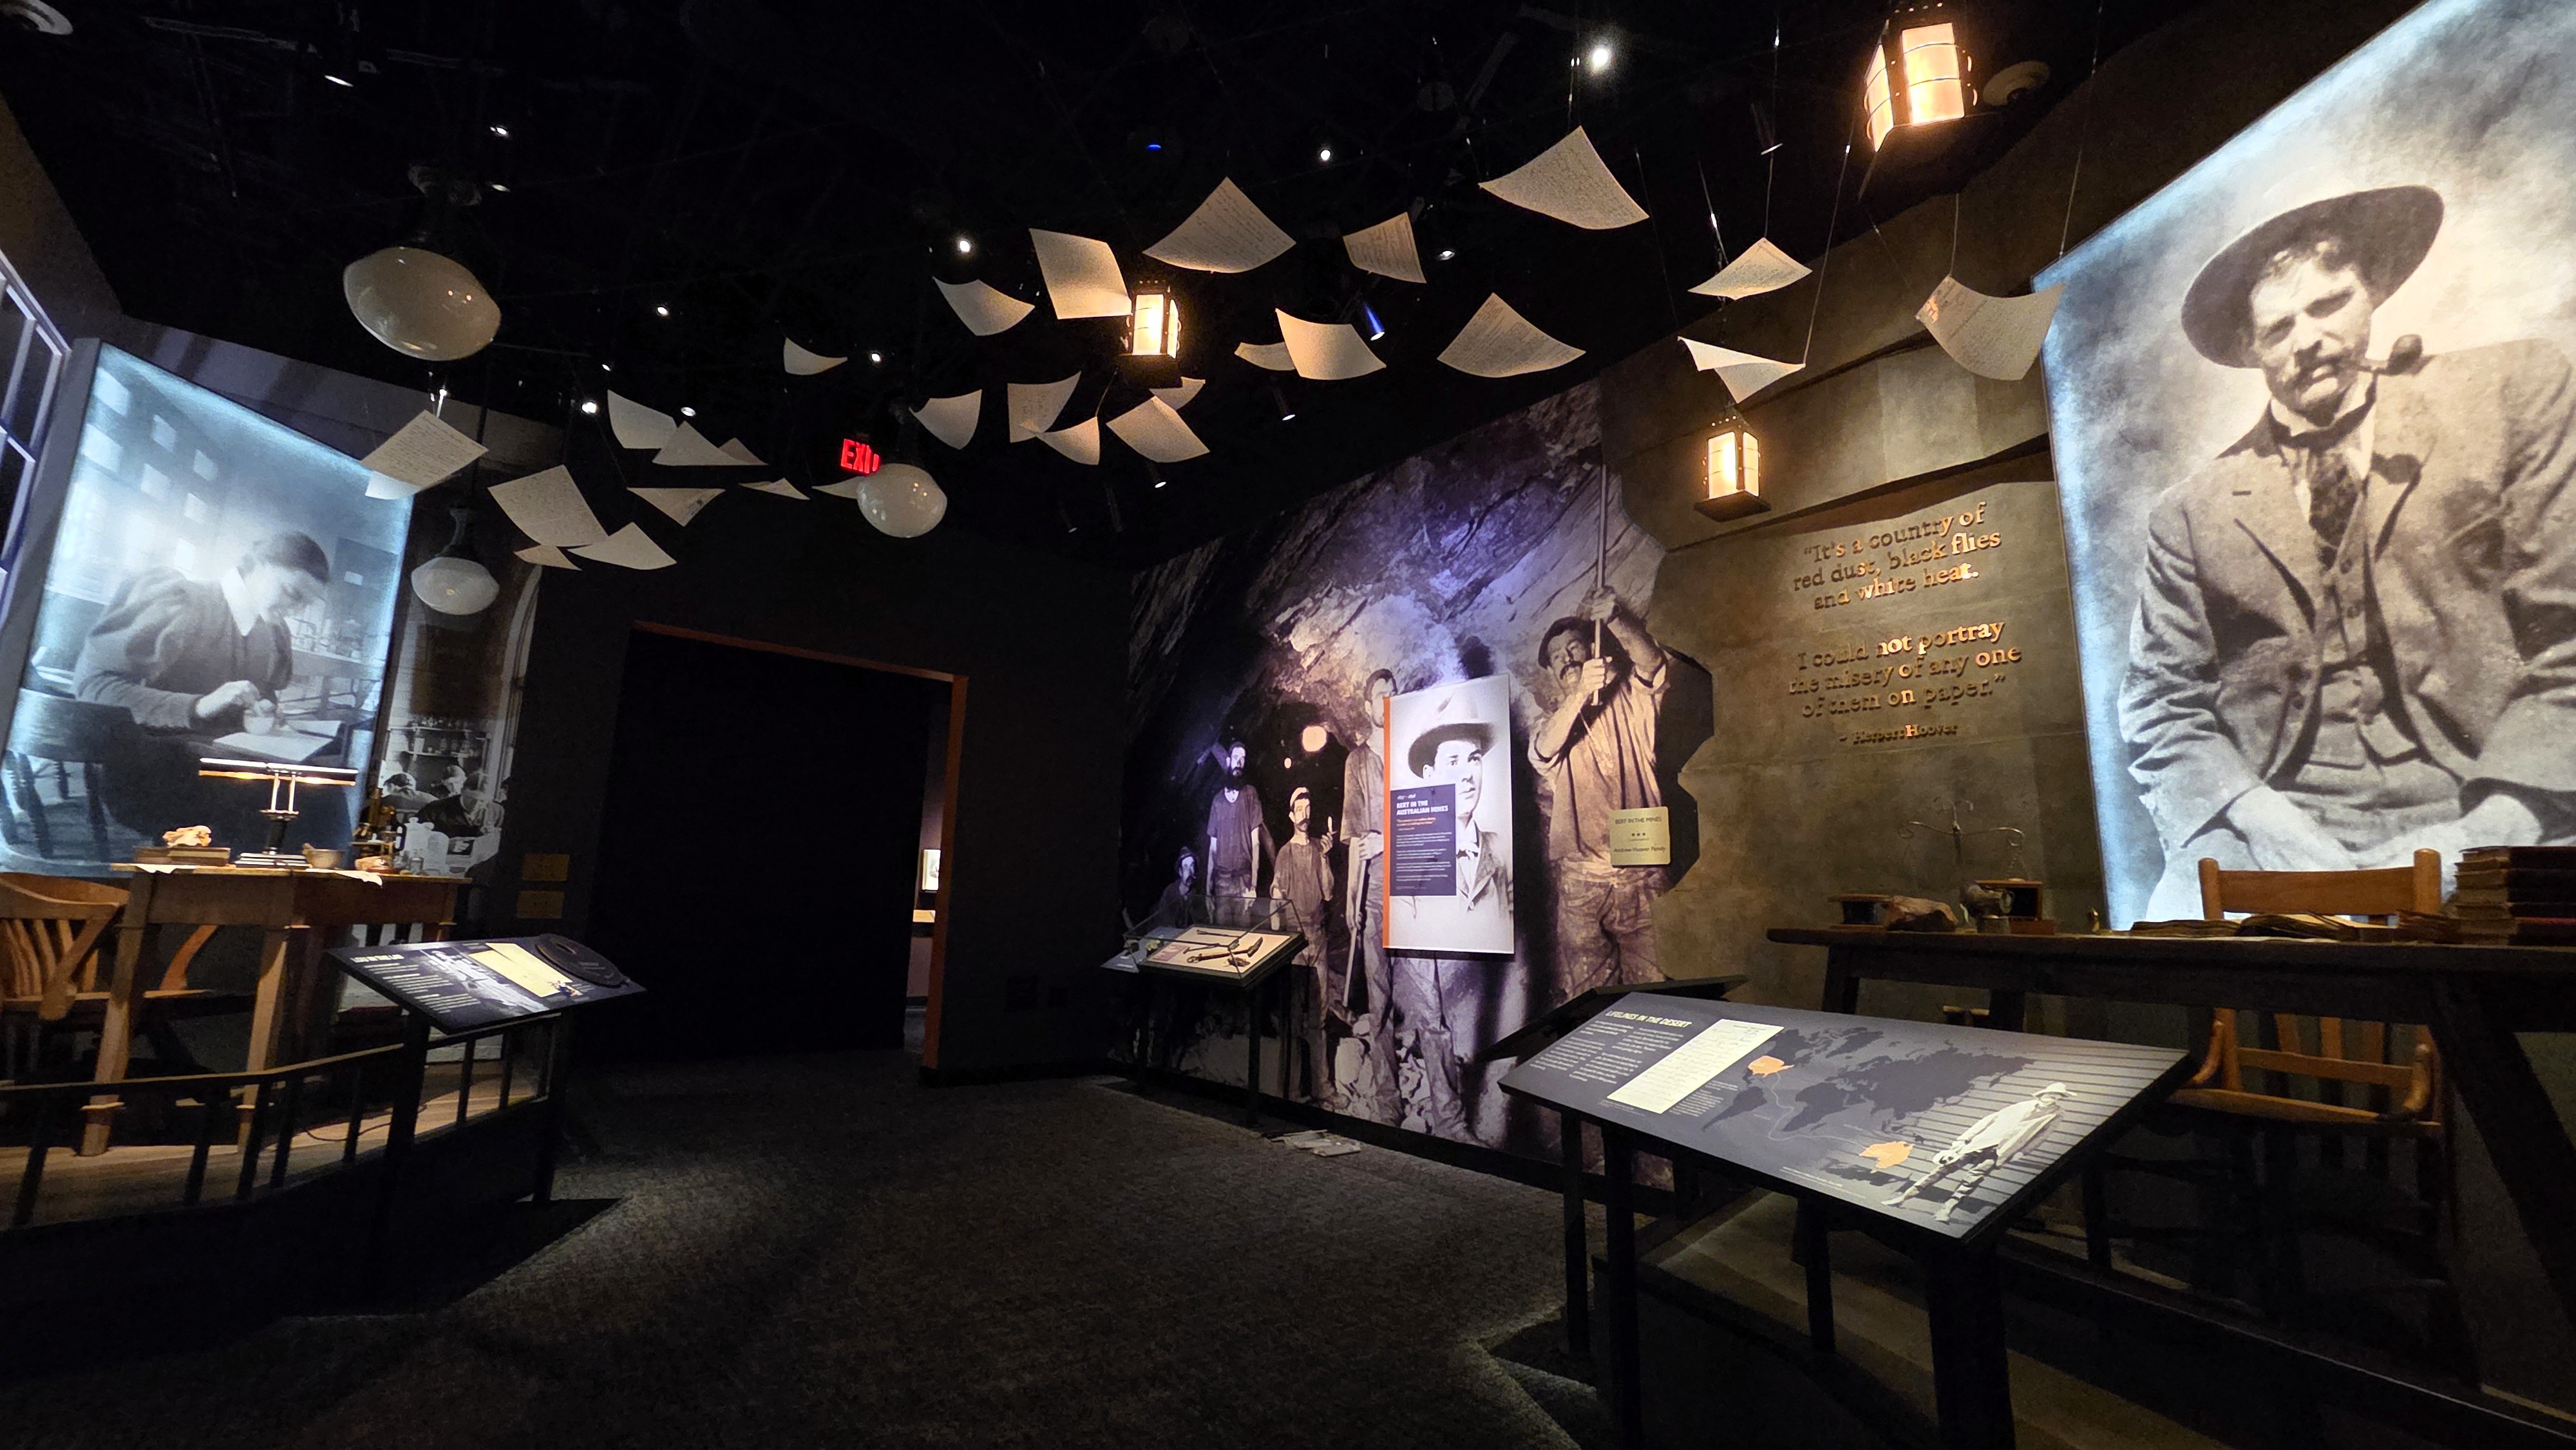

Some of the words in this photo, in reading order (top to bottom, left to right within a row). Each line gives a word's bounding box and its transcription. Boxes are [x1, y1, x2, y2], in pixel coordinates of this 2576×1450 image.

[1852, 539, 1863, 554] a
[1869, 514, 1954, 549] country
[1959, 501, 1987, 526] of
[1793, 567, 1824, 591] red
[1831, 562, 1882, 583] dust,
[1888, 541, 1947, 570] black
[1951, 531, 2002, 555] flies
[1814, 588, 1850, 610] and
[1858, 576, 1917, 601] white
[1923, 562, 1979, 587] heat.
[1788, 675, 1820, 695] the
[1825, 664, 1894, 690] misery
[1899, 657, 1924, 678] of
[1929, 654, 1969, 677] any
[1975, 645, 2023, 667] one
[1798, 653, 1807, 670] I
[1812, 643, 1869, 668] could
[1877, 636, 1913, 656] not
[1917, 620, 2005, 657] portray
[1802, 697, 1825, 718] of
[1830, 692, 1880, 715] them
[1887, 688, 1917, 706] on
